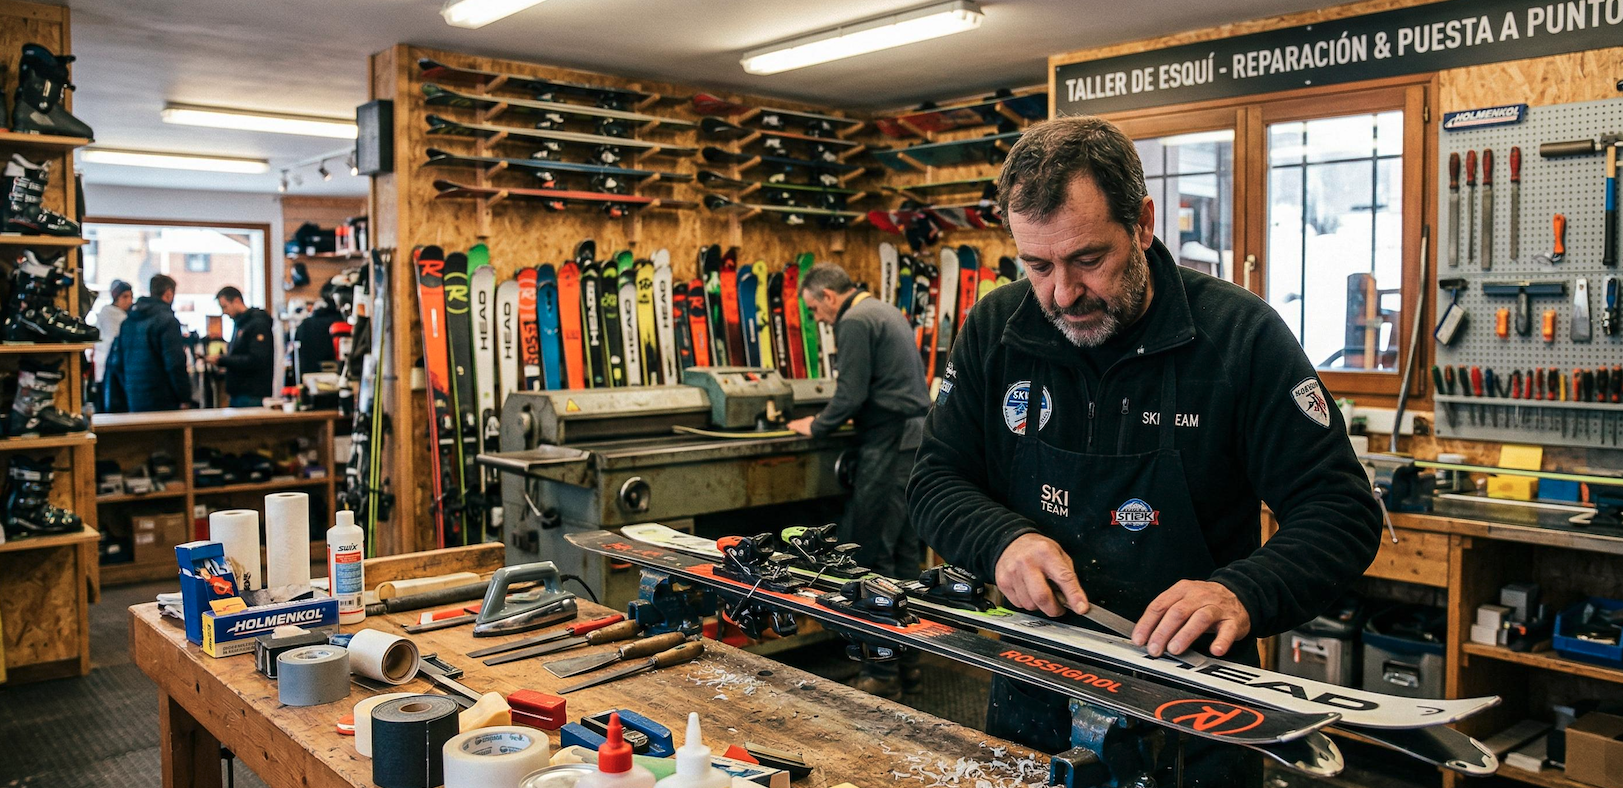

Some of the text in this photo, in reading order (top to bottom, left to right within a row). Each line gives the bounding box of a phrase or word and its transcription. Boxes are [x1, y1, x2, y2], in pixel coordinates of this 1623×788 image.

[1066, 71, 1127, 102] TALLER
[1131, 67, 1154, 93] DE
[1159, 52, 1215, 89] ESQUÍ
[1233, 31, 1367, 79] REPARACIÓN
[1374, 31, 1392, 60] &
[1398, 15, 1494, 56] PUESTA
[1499, 11, 1520, 41] A
[1527, 0, 1623, 38] PUNTO
[1455, 106, 1519, 122] HOLMENKOL
[479, 291, 488, 350] HEAD
[504, 302, 512, 359] HEAD
[1142, 411, 1199, 427] SKI EAM
[1041, 484, 1069, 507] SKI
[1041, 500, 1069, 517] TEAM
[231, 608, 323, 632] HOLMENKOL
[999, 650, 1123, 693] ROSSIGNOL
